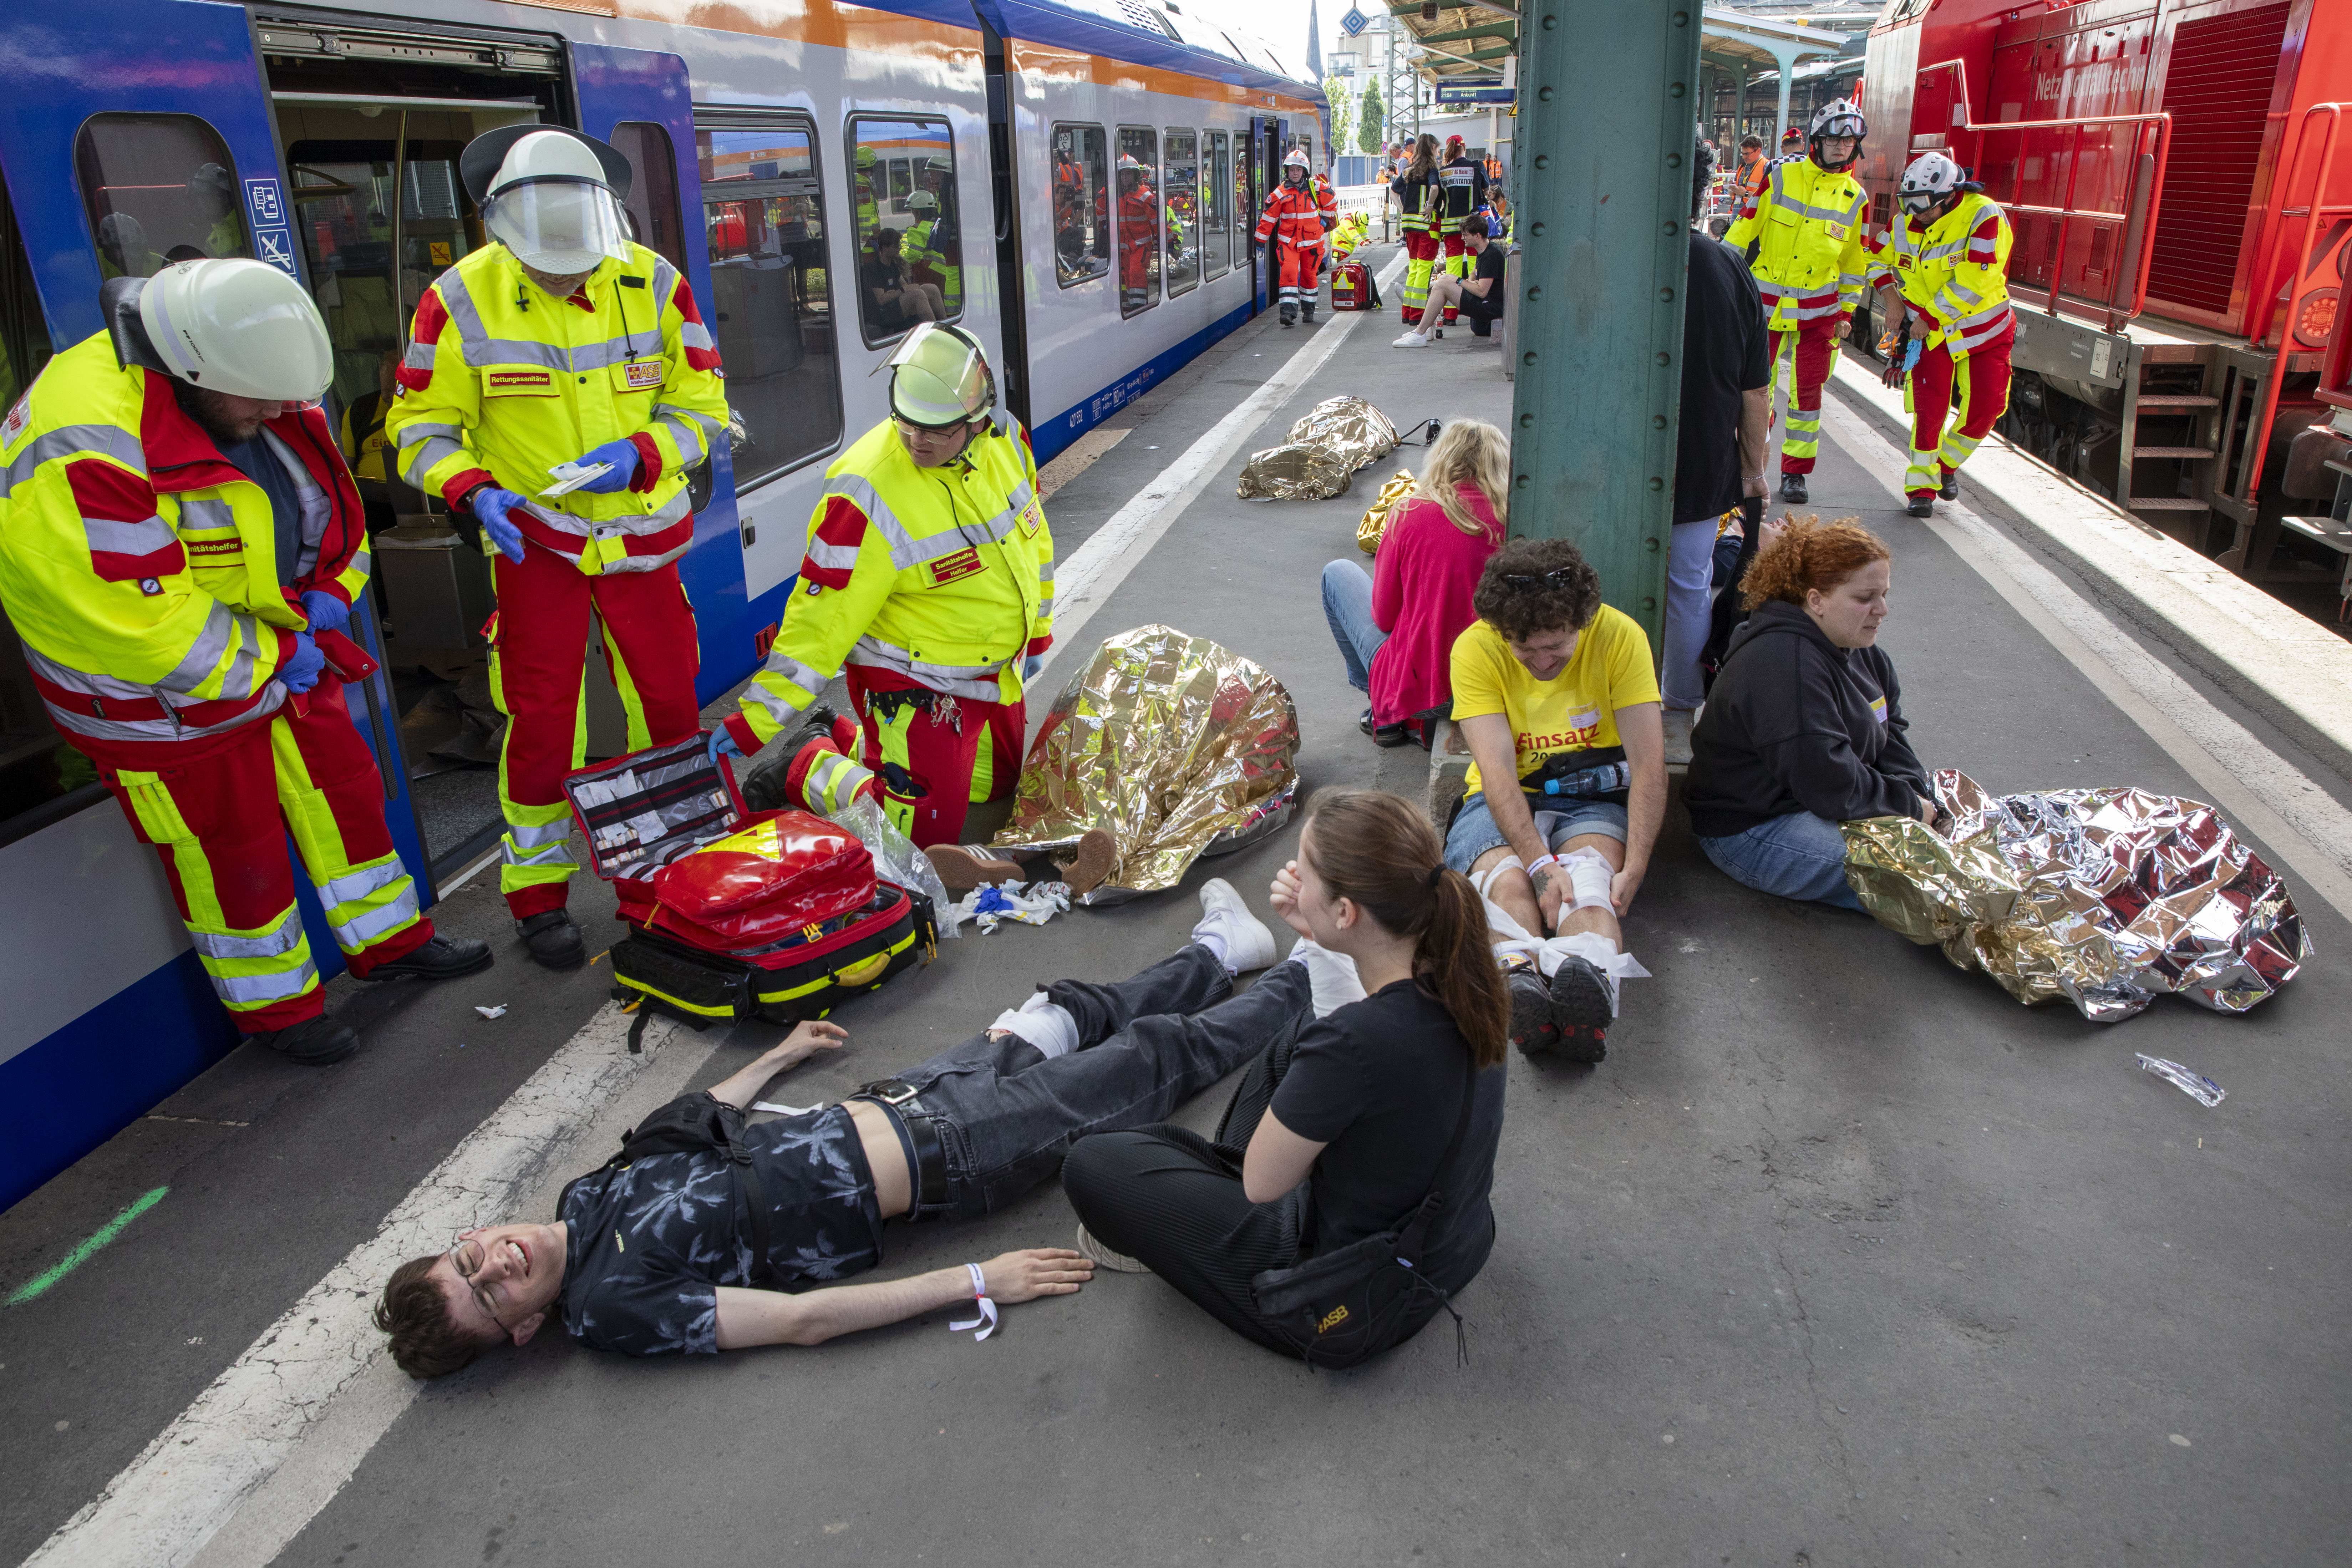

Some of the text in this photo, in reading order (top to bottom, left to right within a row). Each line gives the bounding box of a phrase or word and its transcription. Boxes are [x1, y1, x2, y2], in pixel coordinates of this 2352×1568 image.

[2035, 54, 2161, 101] Netz Notfalltechnik
[1442, 178, 1473, 187] DOKUMENTATION
[639, 364, 660, 379] ASB
[372, 439, 391, 447] Ein
[188, 543, 238, 552] anitätshelfer
[936, 552, 973, 569] Sanitätshelfer
[950, 567, 967, 577] Helfer
[1515, 723, 1600, 753] Einsatz
[1323, 1305, 1348, 1330] ASB
